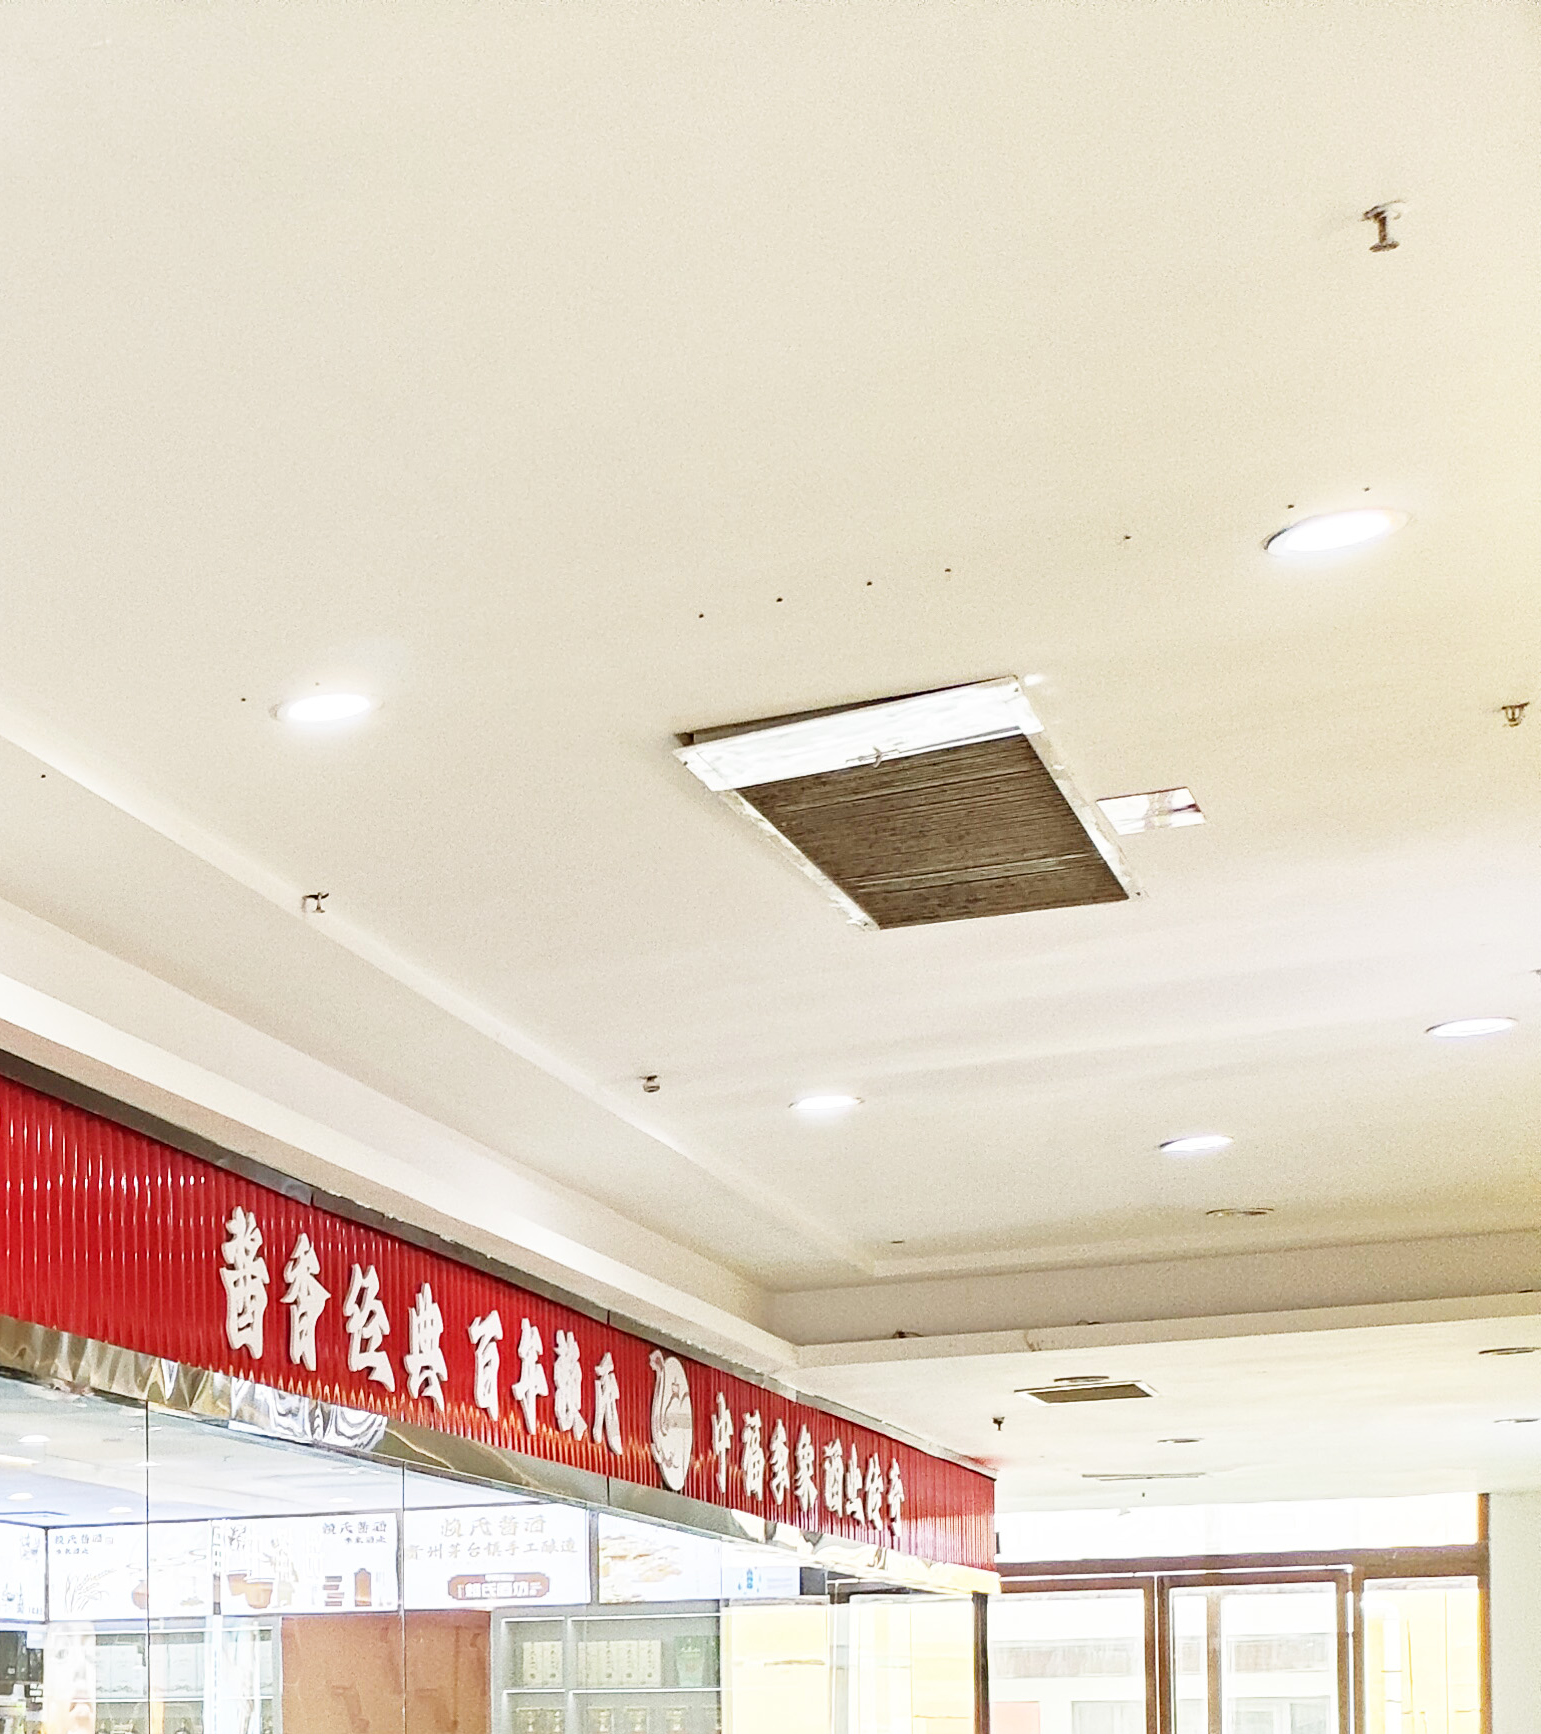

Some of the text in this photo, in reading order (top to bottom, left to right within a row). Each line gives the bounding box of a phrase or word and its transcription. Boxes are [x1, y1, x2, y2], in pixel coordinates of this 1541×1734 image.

[219, 1205, 624, 1456] 酱香经典 百年赖氏
[711, 1391, 905, 1537] 中福季象酒业传奇
